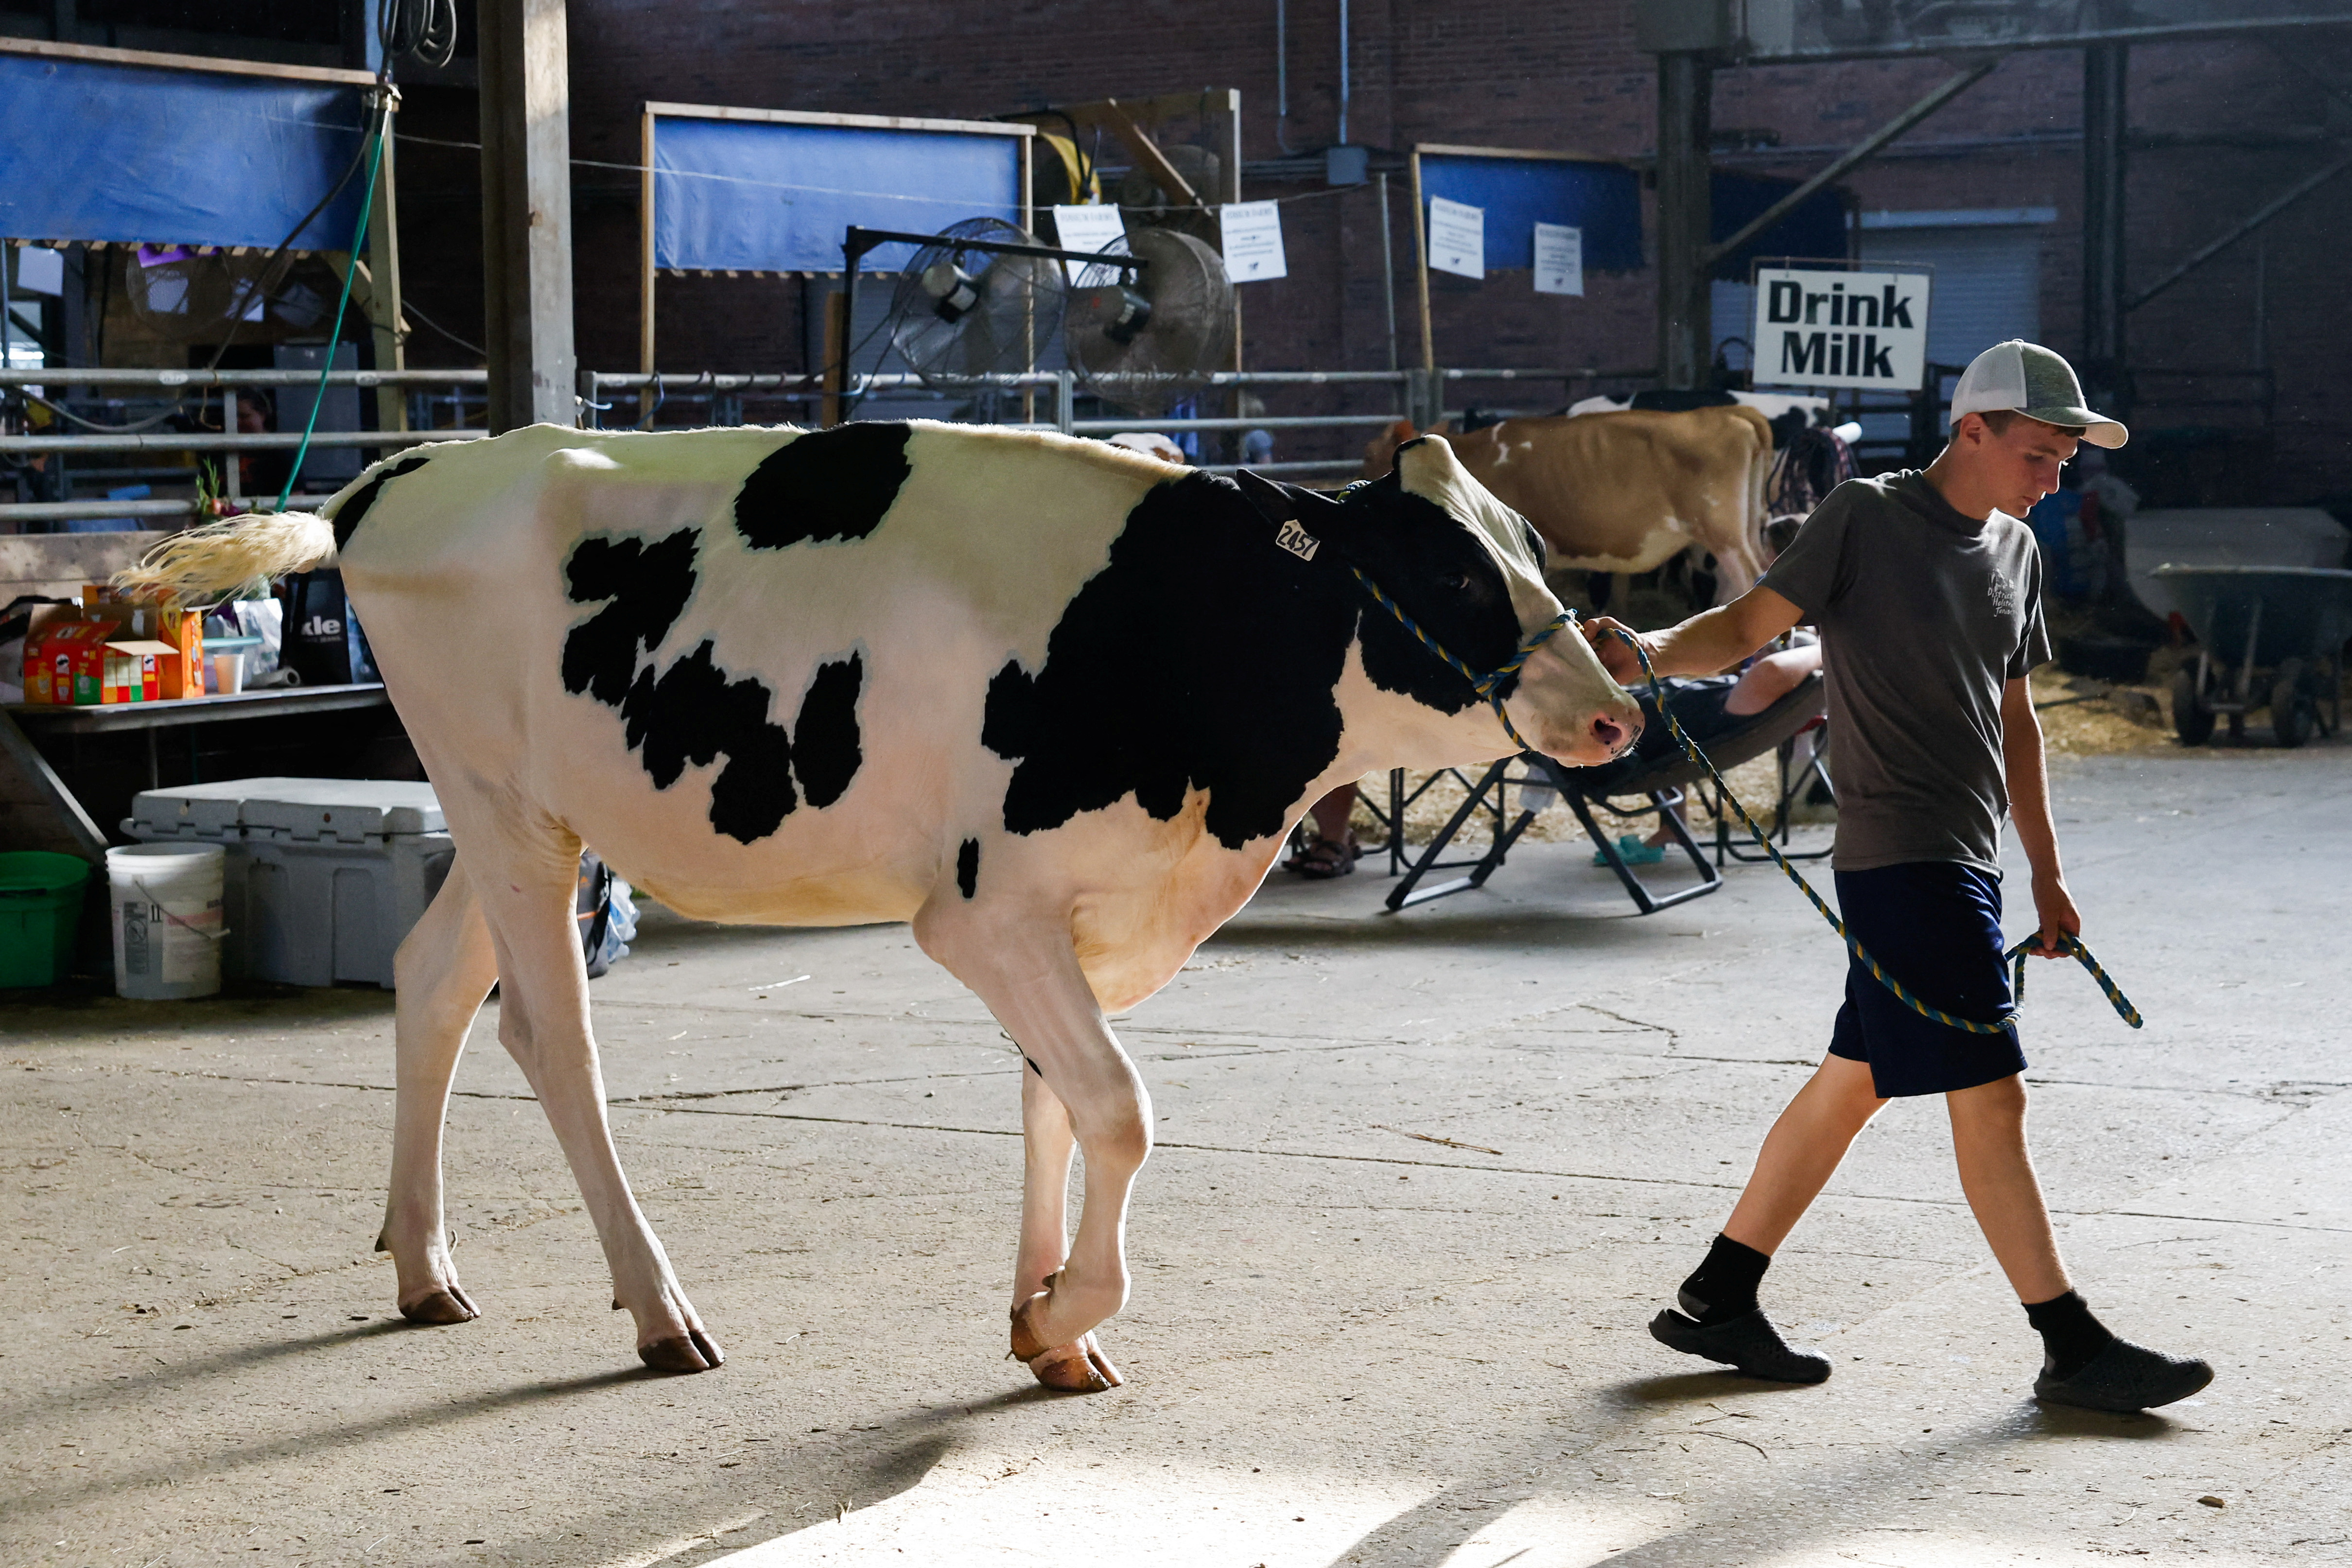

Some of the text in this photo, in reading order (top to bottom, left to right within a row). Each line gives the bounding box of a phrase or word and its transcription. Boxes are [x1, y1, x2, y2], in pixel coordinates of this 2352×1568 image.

[1768, 280, 1914, 329] Drink
[1780, 331, 1894, 378] Milk
[1277, 525, 1319, 557] 2457
